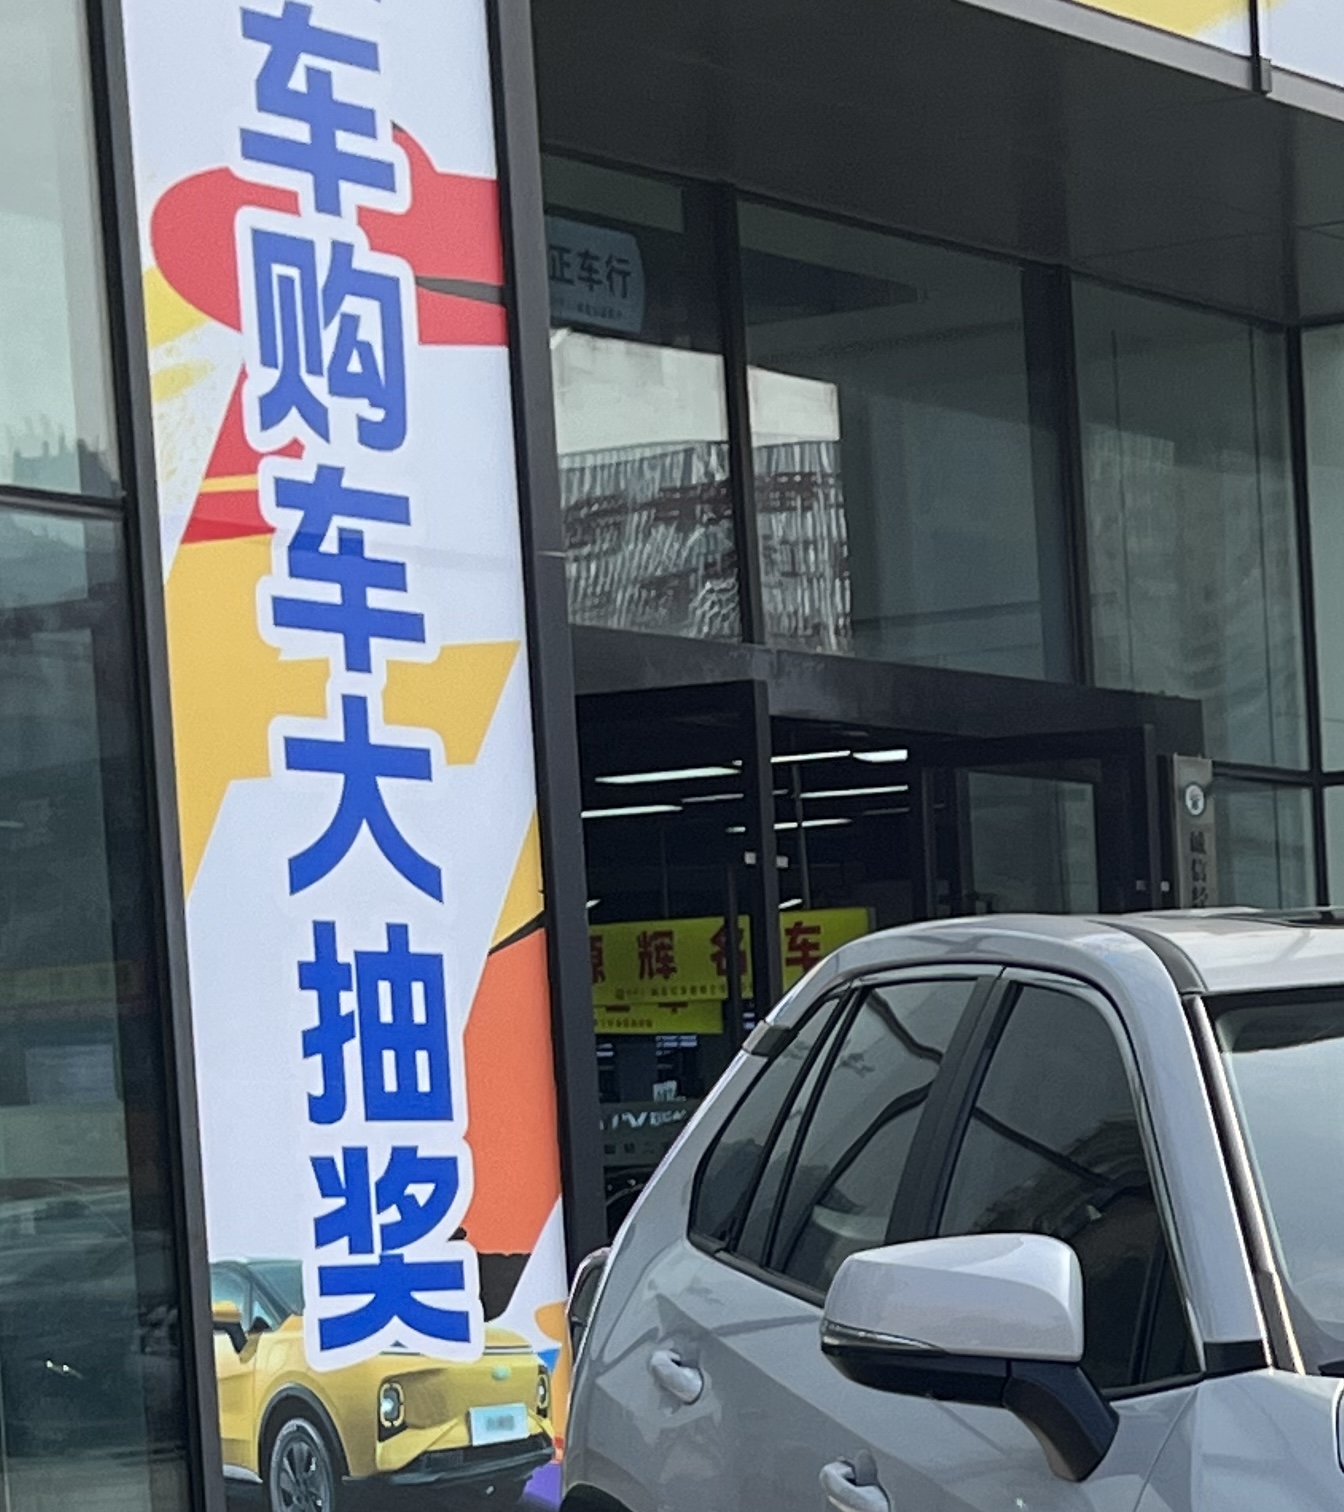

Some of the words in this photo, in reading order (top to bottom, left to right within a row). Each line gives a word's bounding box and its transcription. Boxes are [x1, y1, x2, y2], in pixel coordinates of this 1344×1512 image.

[239, 0, 472, 1352] 车购车大抽奖
